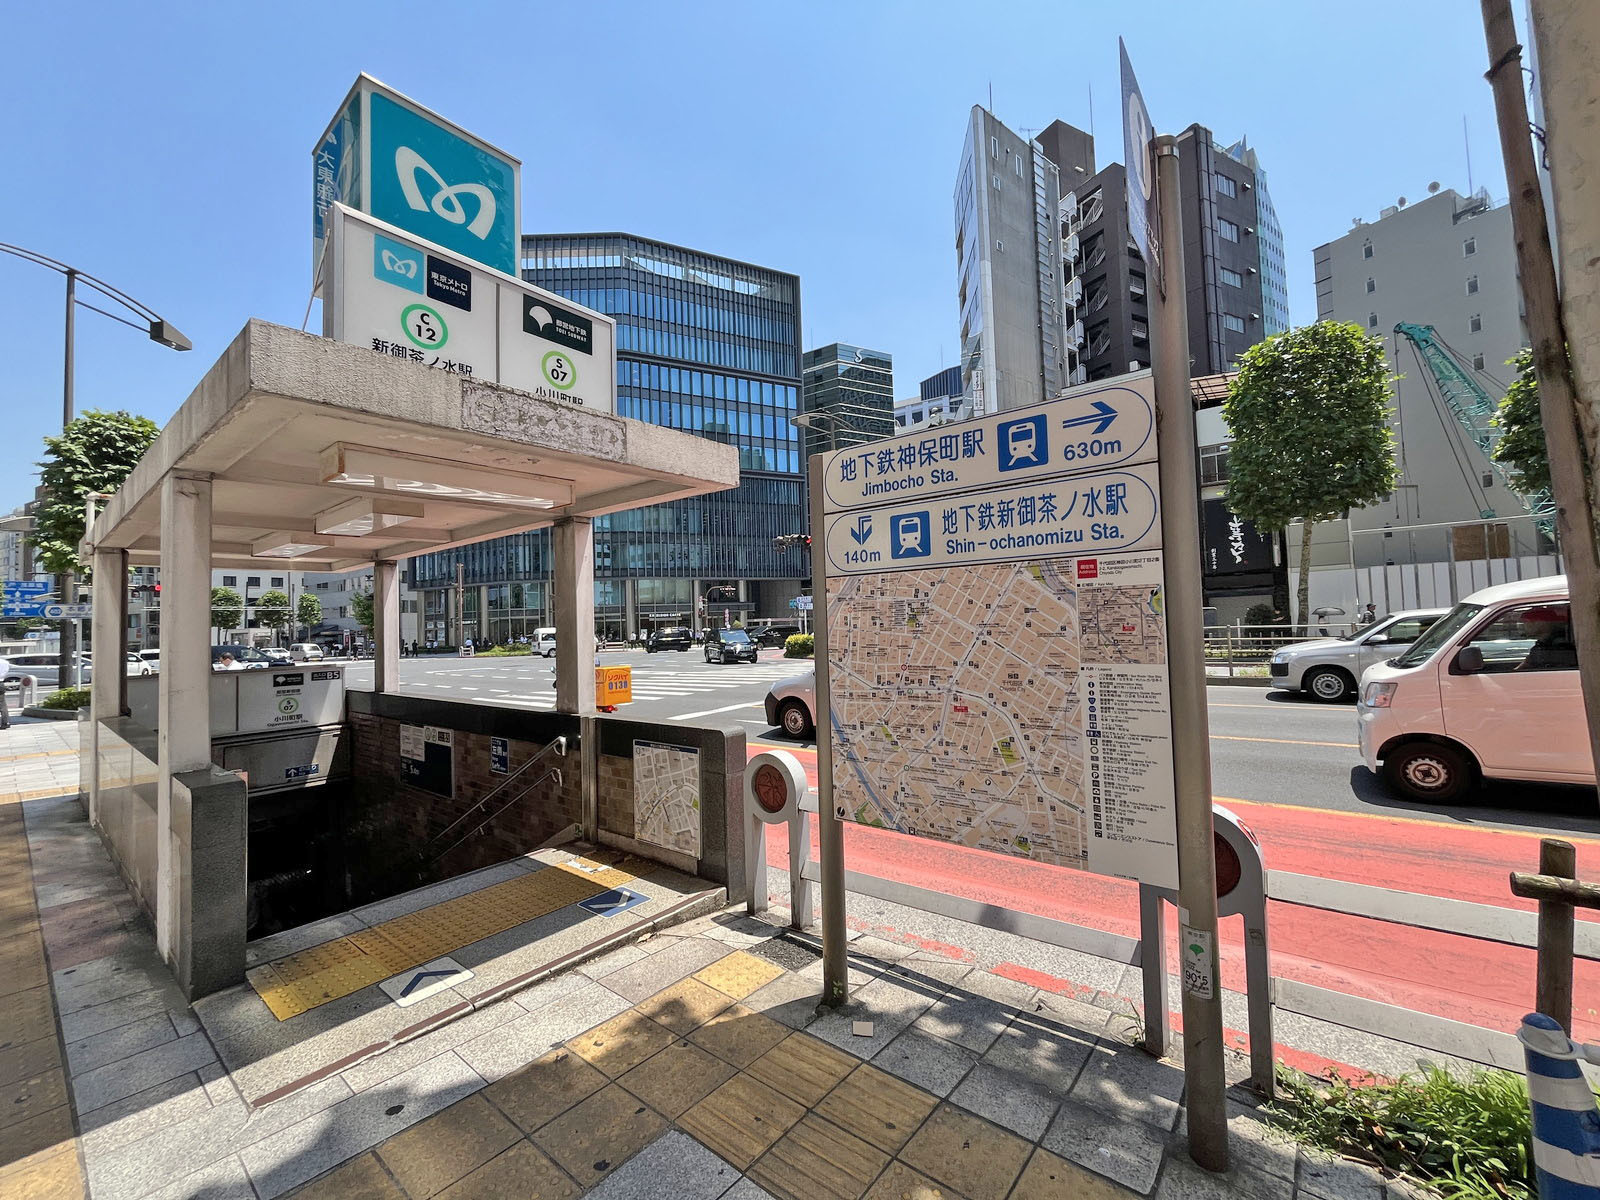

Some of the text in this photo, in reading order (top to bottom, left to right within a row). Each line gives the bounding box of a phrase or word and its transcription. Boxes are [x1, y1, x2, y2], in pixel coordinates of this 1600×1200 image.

[431, 271, 468, 291] 東京メトロ
[433, 279, 466, 297] Tokyo Metro
[420, 312, 430, 325] C
[415, 324, 437, 341] 12
[556, 319, 587, 336] 都営地下鉄
[567, 331, 587, 342] SUBWAY
[556, 358, 563, 369] S
[551, 368, 567, 381] 07
[840, 428, 985, 482] 地下鉄神保町駅
[1063, 439, 1122, 461] 630m
[862, 469, 959, 496] Jimbocho Sta.
[942, 482, 1128, 535] 地下鉄新御茶ノ水駅
[1091, 522, 1125, 540] Sta.
[844, 549, 881, 564] 140m
[326, 671, 339, 679] B5
